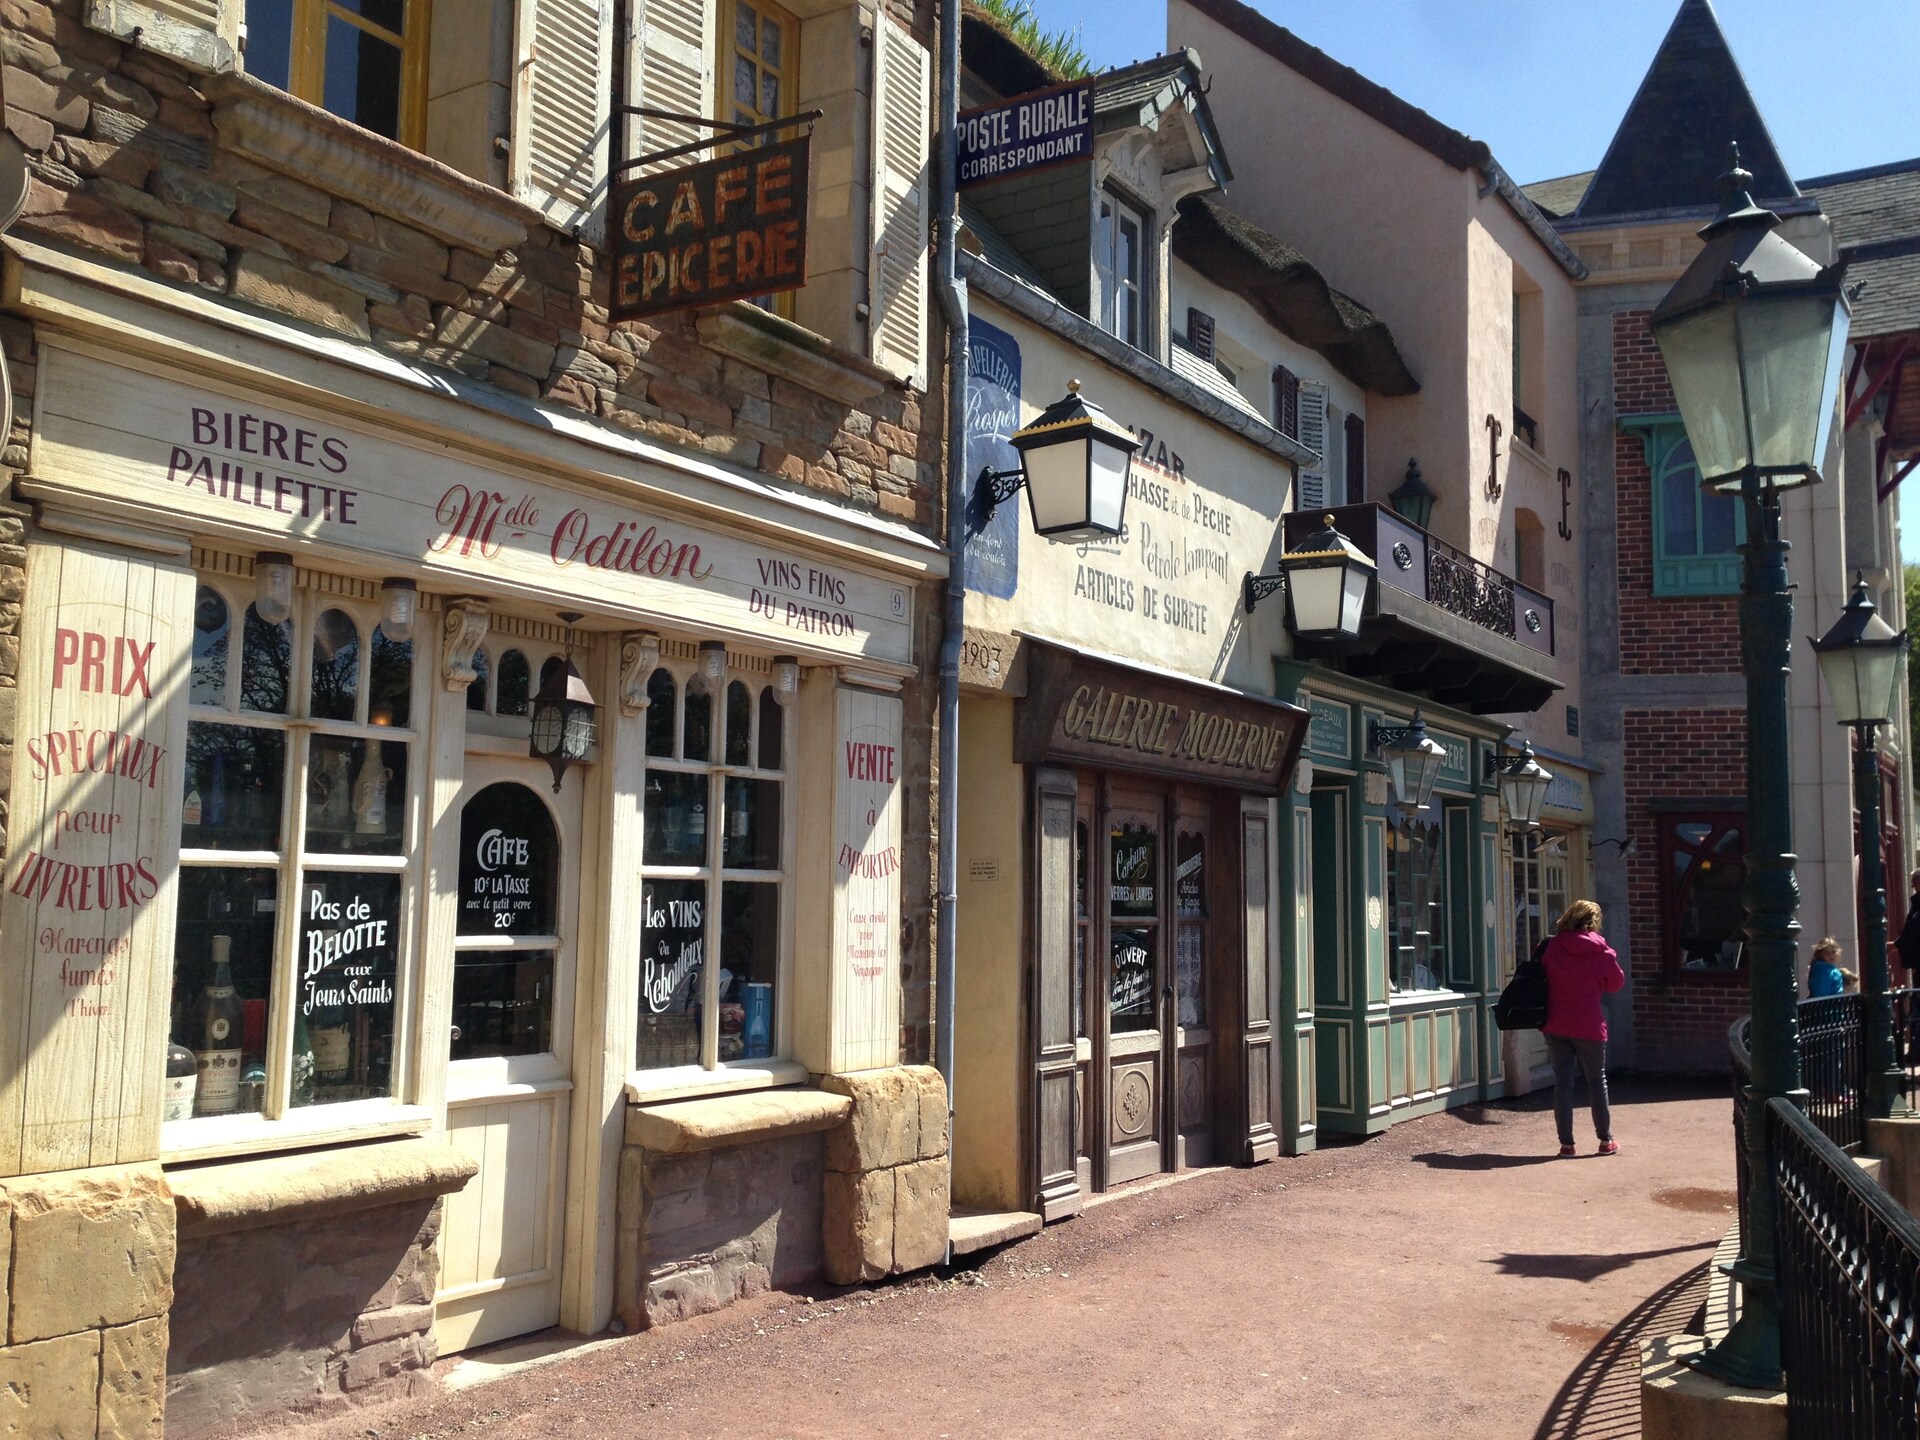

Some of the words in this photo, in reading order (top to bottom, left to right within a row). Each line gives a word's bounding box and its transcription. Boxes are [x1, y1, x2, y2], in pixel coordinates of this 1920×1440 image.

[957, 109, 1011, 156] POSTE
[1019, 89, 1089, 141] RURALE
[961, 133, 1084, 180] CORRESPONDANT
[623, 154, 793, 243] CAFE
[617, 220, 800, 306] EPICERIE
[968, 344, 1019, 394] APELLERIE
[191, 406, 349, 474] BIÈRES
[166, 446, 358, 525] PAILLETTE
[1126, 472, 1169, 513] HASSE
[550, 508, 714, 580] Odilon
[1140, 520, 1181, 581] Pétrole
[1183, 536, 1229, 585] lampant
[757, 557, 802, 592] VINS
[808, 569, 847, 605] FINS
[1074, 563, 1135, 613] ARTICLES
[1143, 585, 1158, 621] DE
[749, 587, 775, 620] DU
[786, 600, 855, 638] PATRON
[53, 627, 156, 699] PRIX
[962, 641, 1003, 674] 1903
[1061, 684, 1180, 756] GALERIE
[1173, 708, 1286, 774] MODERNE
[27, 720, 168, 790] SPÉCIAUX
[846, 740, 896, 785] VENTE
[54, 808, 123, 850] pour
[866, 798, 877, 828] à
[476, 828, 530, 872] CAFE
[838, 843, 900, 880] EMPORTER
[1116, 845, 1149, 880] Carbure
[9, 850, 159, 914] LIVREURS
[310, 889, 341, 920] Pas
[346, 895, 371, 920] de
[466, 899, 481, 910] avec
[493, 897, 510, 913] petit
[492, 877, 503, 894] LA
[504, 874, 530, 896] TASSE
[1110, 886, 1130, 901] VERRES
[1135, 886, 1154, 901] LAMPES
[645, 894, 666, 928] Les
[668, 899, 701, 928] VINS
[40, 927, 129, 964] Harengs
[303, 919, 388, 980] BELOTTE
[1114, 946, 1148, 969] OUVERT
[58, 957, 114, 995] fumés
[343, 965, 373, 976] aux
[643, 937, 703, 1013] Rebouteux
[303, 980, 346, 1017] Jours
[347, 978, 393, 1006] Saints
